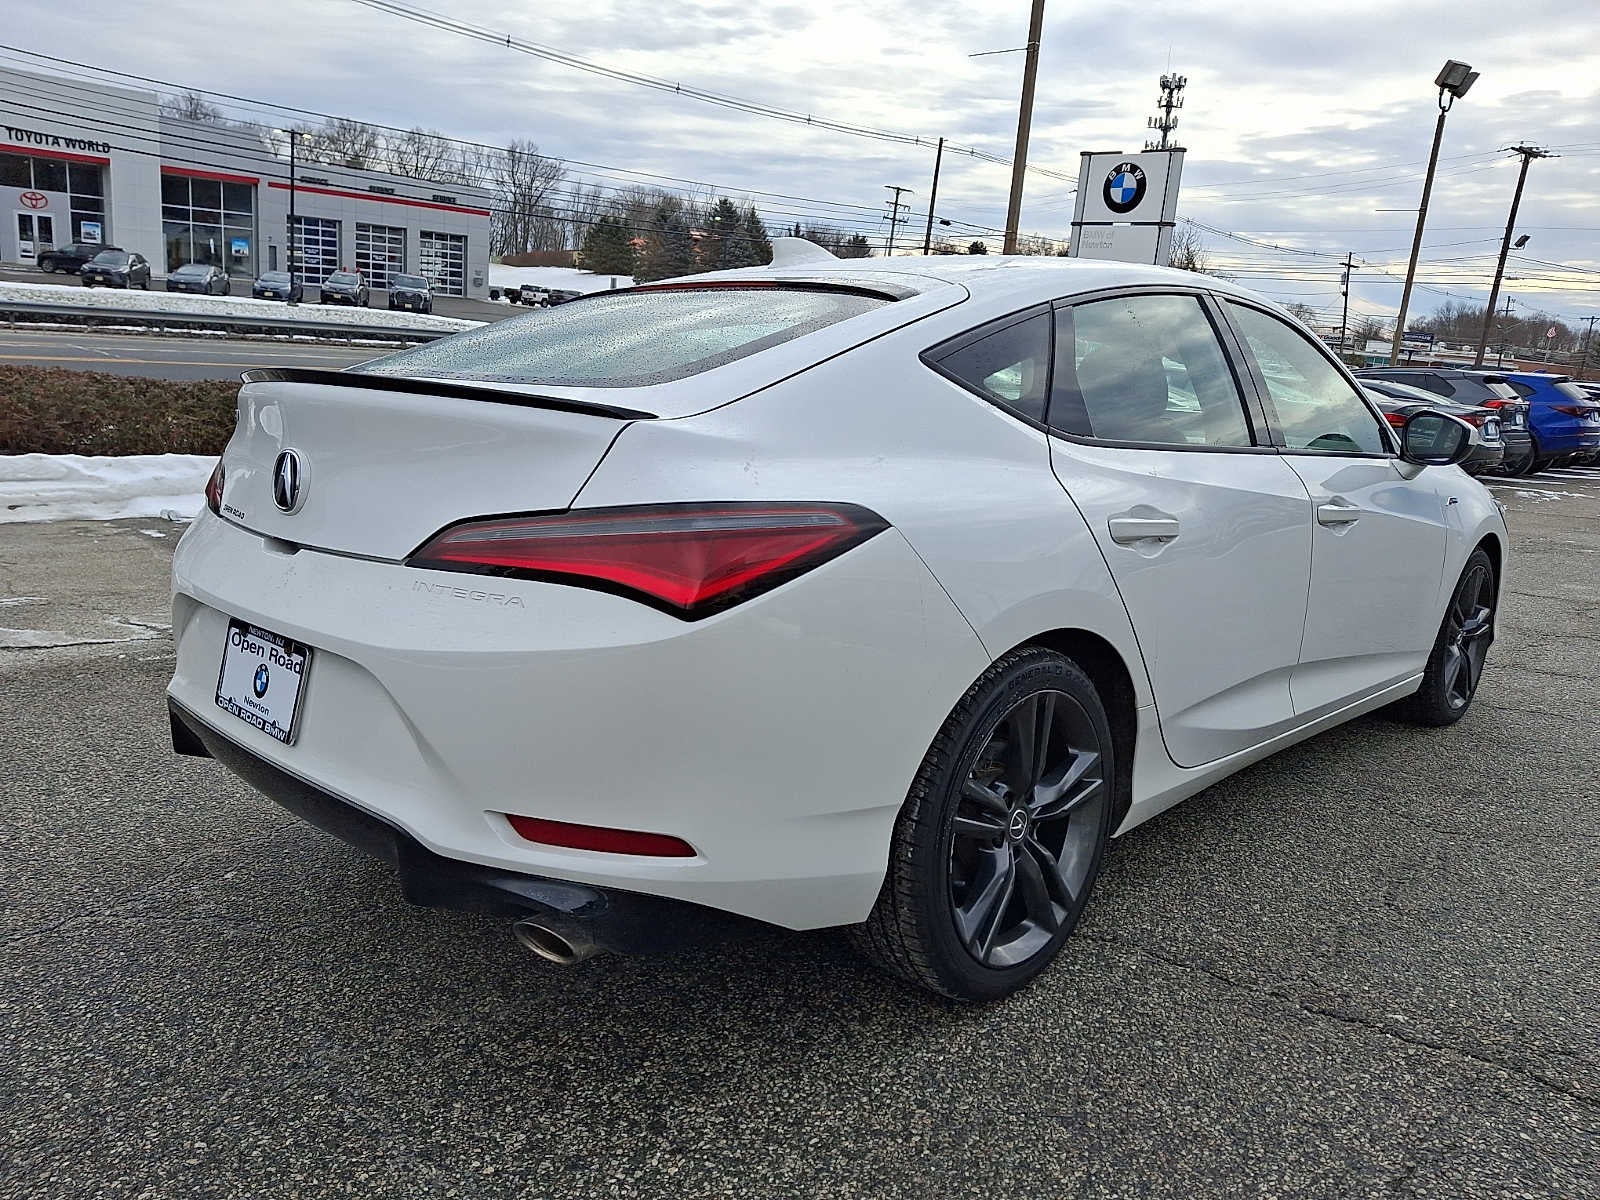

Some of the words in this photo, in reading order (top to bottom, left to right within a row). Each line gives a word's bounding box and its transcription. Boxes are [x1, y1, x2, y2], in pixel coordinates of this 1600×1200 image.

[5, 126, 61, 148] TOYOTA
[64, 137, 111, 154] WORLD
[1108, 163, 1144, 180] BMW
[1081, 239, 1113, 249] Newton
[1083, 230, 1104, 239] BMW
[411, 579, 526, 609] INTEGRA
[231, 631, 265, 658] Open
[268, 646, 303, 675] Road
[243, 695, 270, 717] Newton
[218, 697, 240, 716] OPEN
[240, 711, 264, 729] ROAD
[264, 722, 288, 741] BMW
